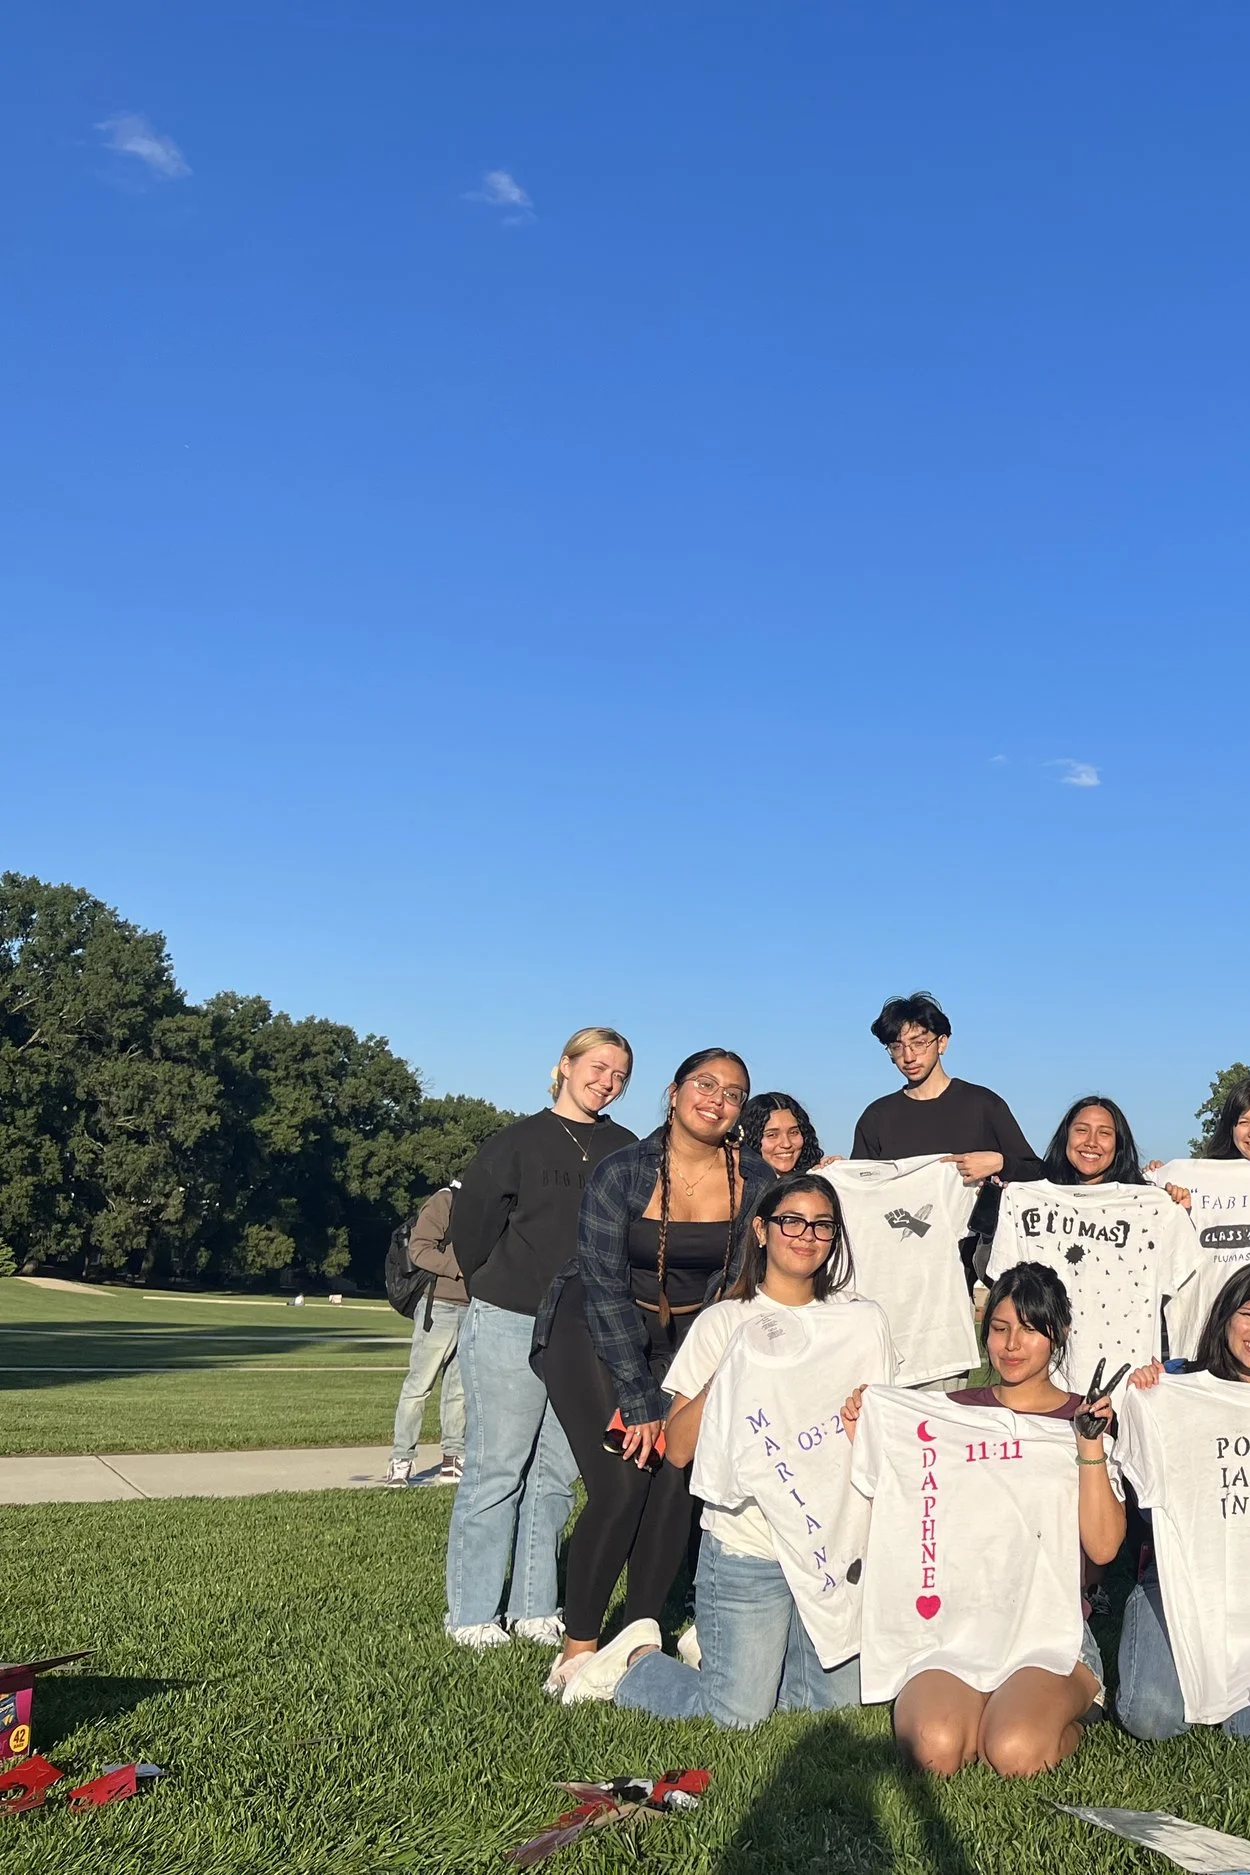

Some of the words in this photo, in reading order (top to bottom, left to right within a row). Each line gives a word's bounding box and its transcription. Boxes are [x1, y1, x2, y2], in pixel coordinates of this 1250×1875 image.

[1204, 1230, 1243, 1242] CLASS
[965, 1440, 1024, 1462] 11:11
[745, 1407, 837, 1592] MARIANA
[920, 1447, 938, 1589] DAPHNE
[13, 1728, 26, 1744] 42
